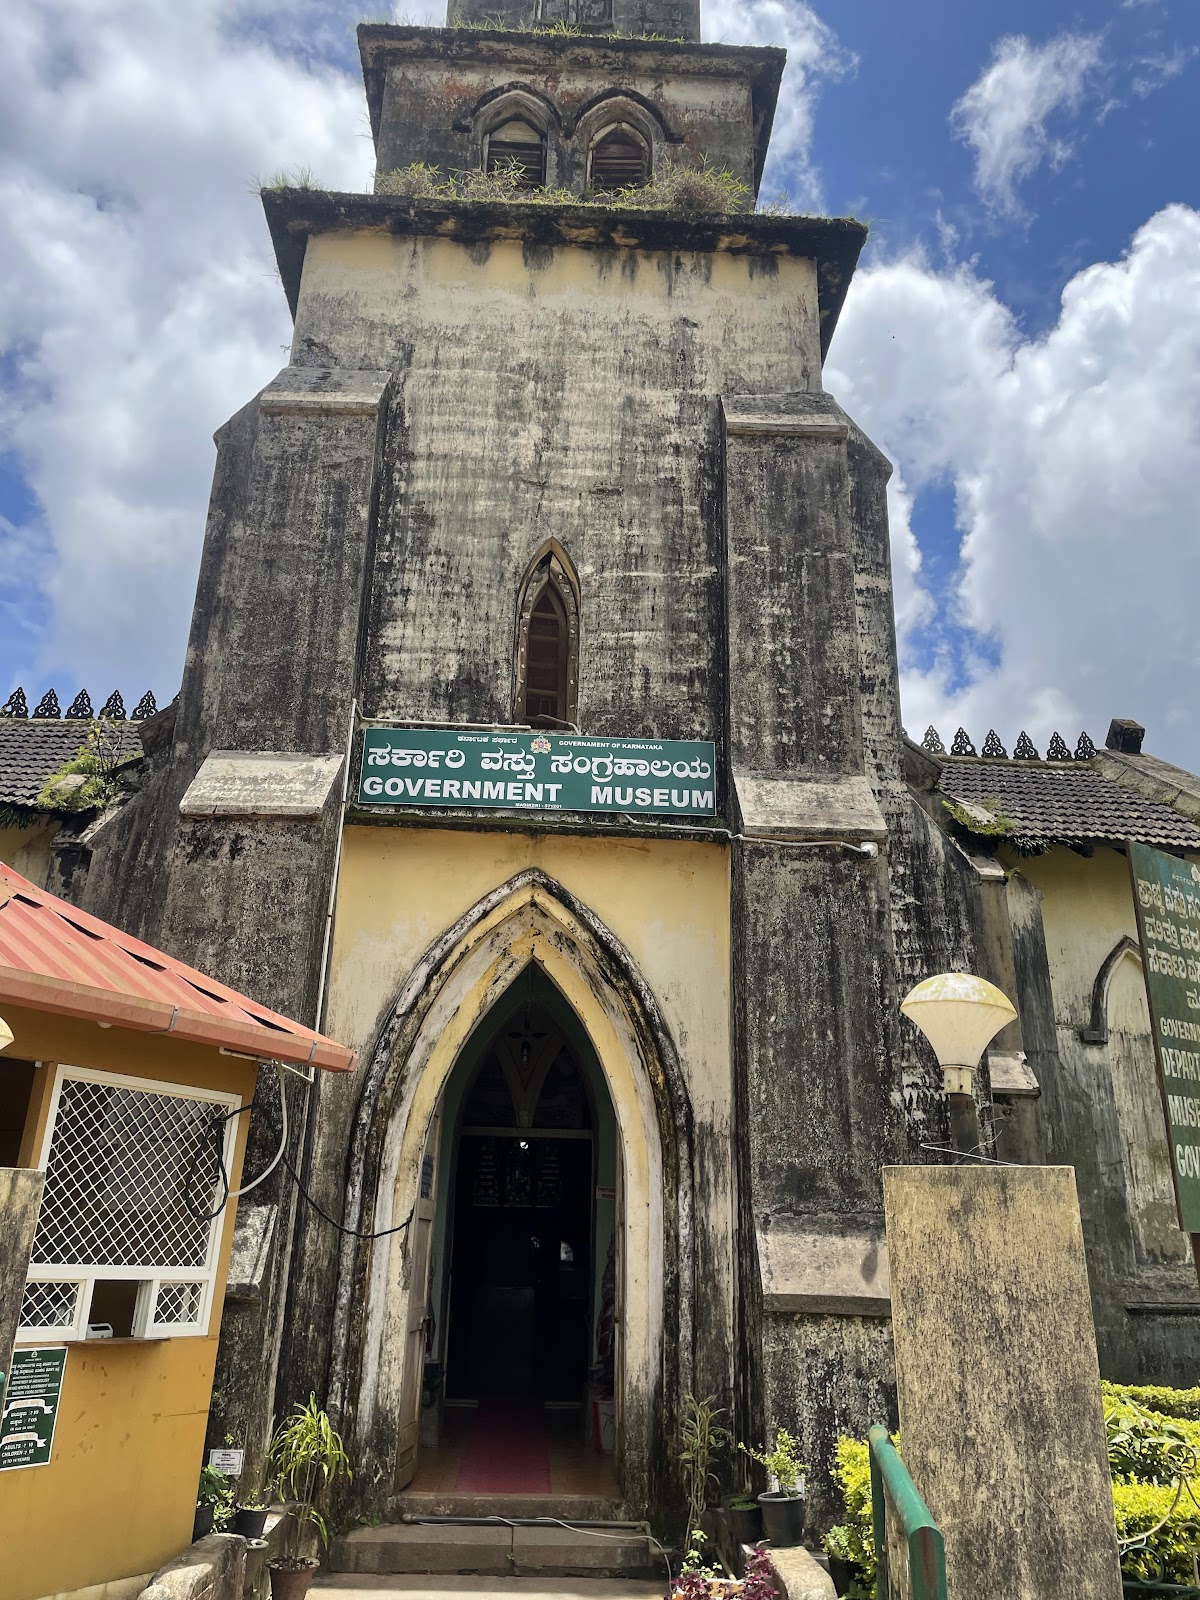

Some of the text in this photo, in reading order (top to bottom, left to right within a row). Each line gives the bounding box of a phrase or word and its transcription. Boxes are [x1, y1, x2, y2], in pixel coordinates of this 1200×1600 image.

[558, 740, 610, 748] GOVERNAMENT
[367, 742, 712, 783] ಸರ್ಕಾರಿ ವಸ್ತು ಸಂಗ್ರಹಾಲಯ
[363, 776, 714, 809] GOVERNMENT MUSEUM
[1147, 944, 1187, 979] ಸರ್ಕಾರಿ
